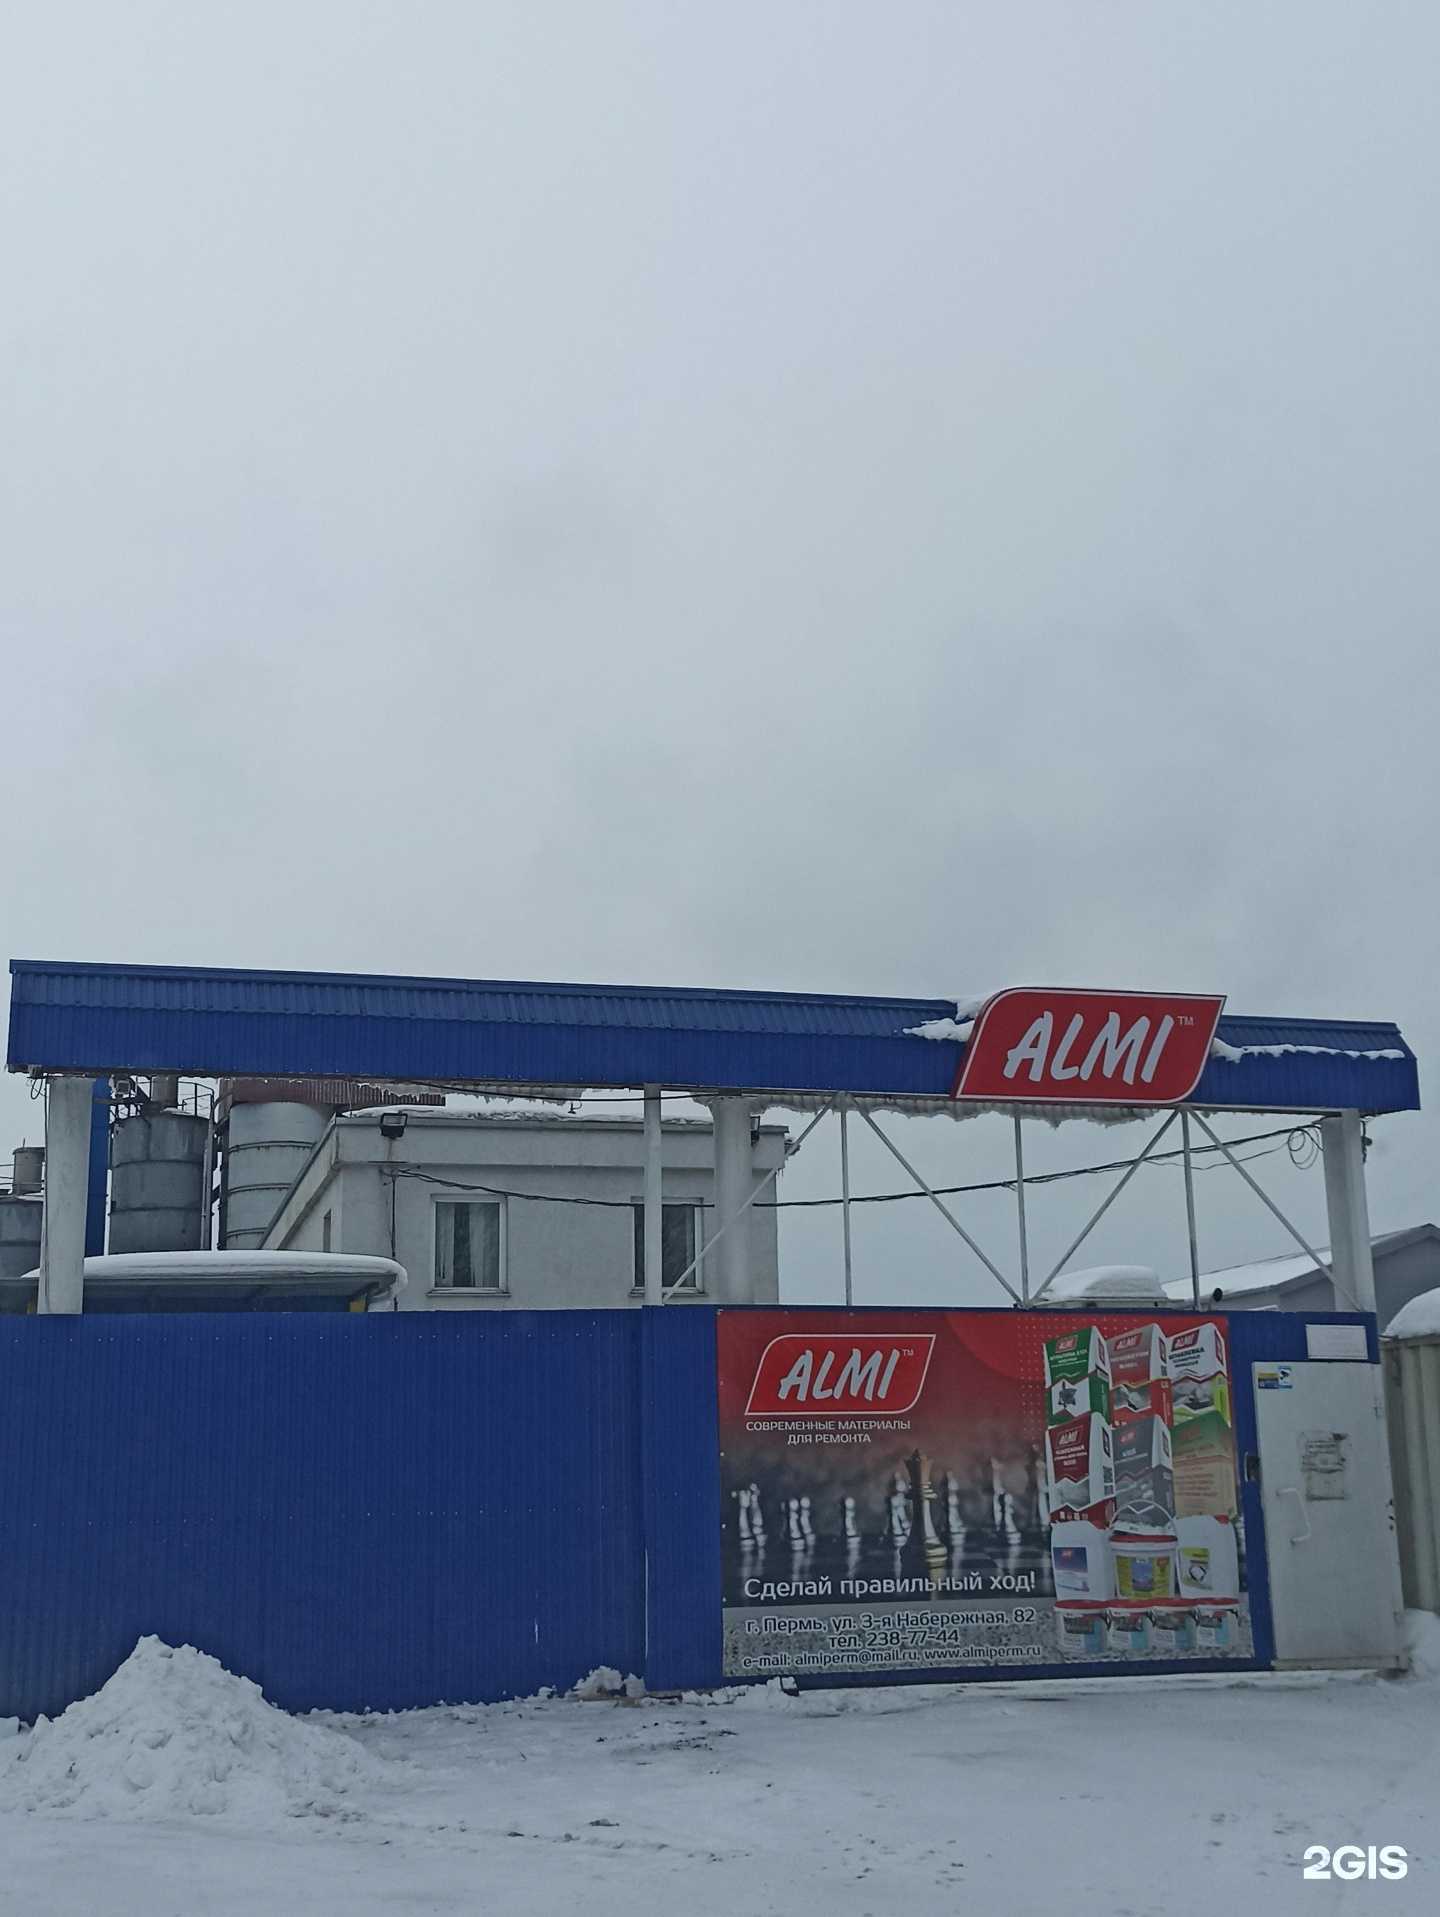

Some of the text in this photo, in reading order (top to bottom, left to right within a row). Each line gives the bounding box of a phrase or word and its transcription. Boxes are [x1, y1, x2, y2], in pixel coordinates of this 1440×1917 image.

[1002, 1010, 1195, 1086] ALMI TM
[777, 1347, 900, 1401] ALMI
[745, 1419, 912, 1432] СОВРЕМЕННЫЕ МАТЕРИАЛЫ
[787, 1432, 872, 1446] ДЛЯ РЕМОНТА
[744, 1570, 1036, 1601] Сделай правильный ход!
[763, 1616, 828, 1635] Пермь,
[831, 1616, 857, 1632] ул.
[861, 1613, 893, 1630] 3-я
[1013, 1607, 1036, 1624] 82
[828, 1628, 960, 1649] тел. 238-77-44
[743, 1652, 791, 1668] e-mail:
[924, 1645, 1042, 1660] www.almiperm.ru
